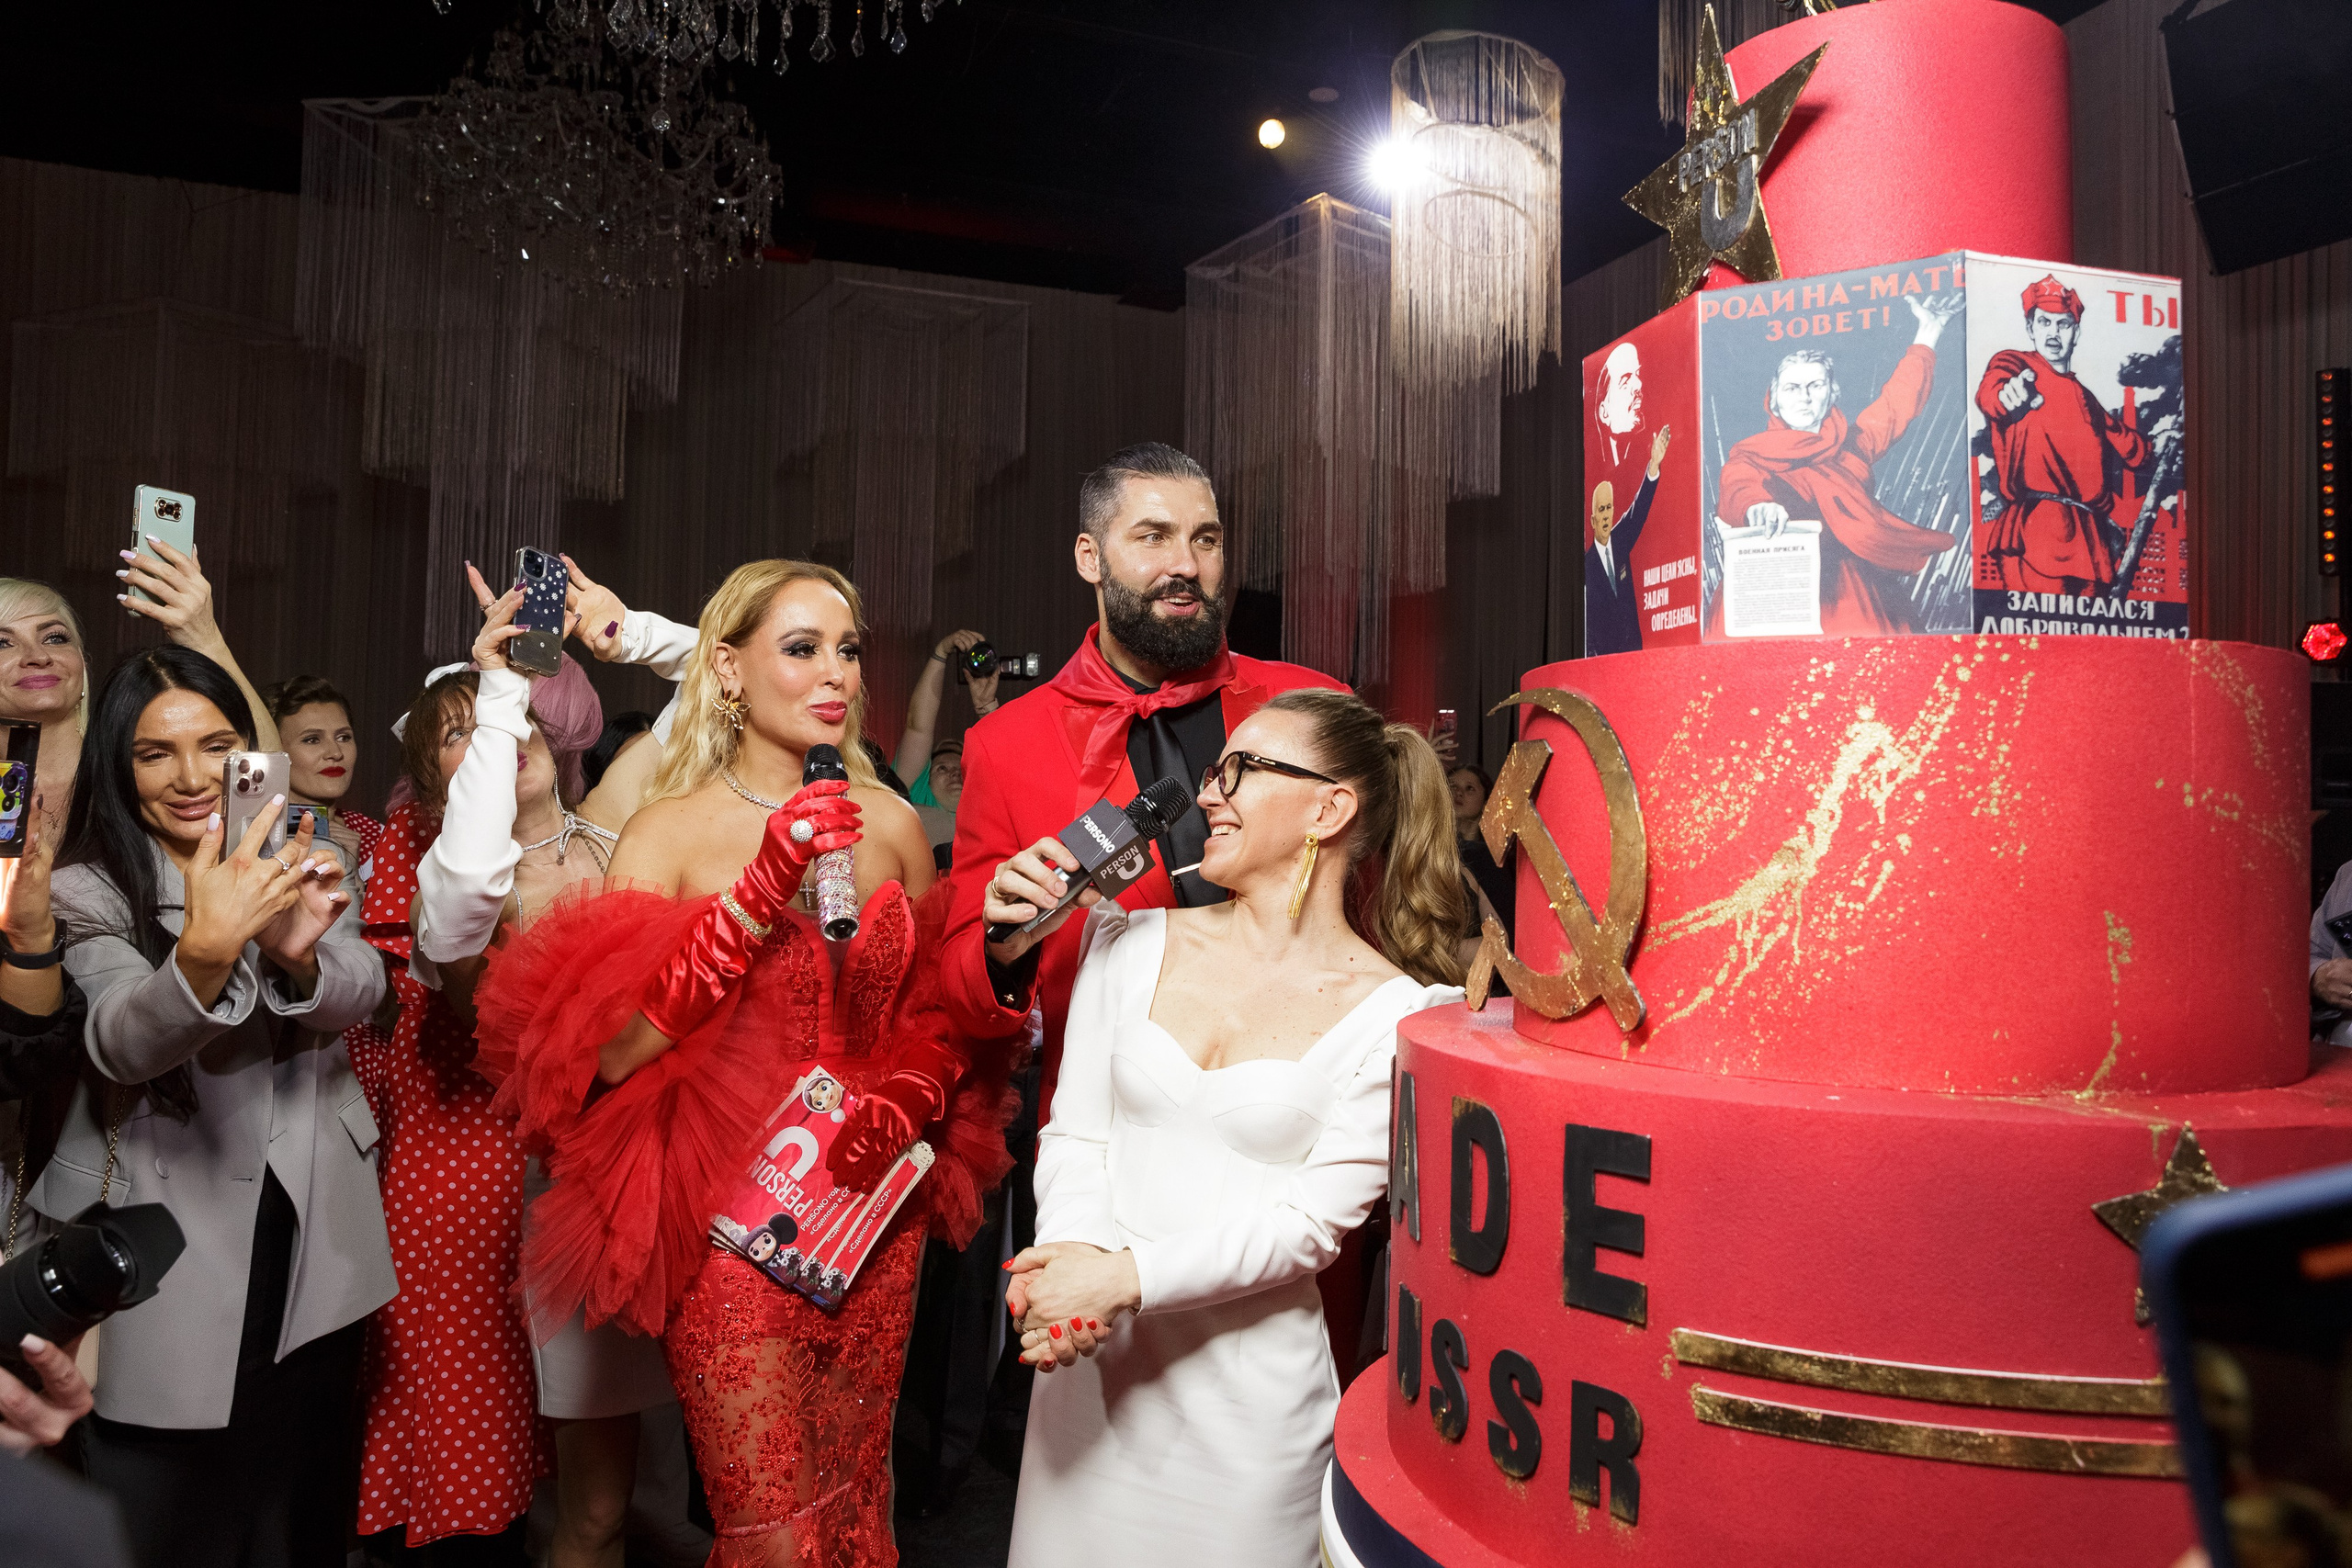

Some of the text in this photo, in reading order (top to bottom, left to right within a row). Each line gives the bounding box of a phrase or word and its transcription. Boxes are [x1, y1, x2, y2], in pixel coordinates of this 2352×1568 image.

[1765, 306, 1890, 342] ЗОВЕТ!
[2107, 289, 2178, 329] ТЫ
[1643, 587, 1668, 611] ЗАДАЧИ
[2007, 590, 2154, 621] ЗАПИСАЛСЯ
[1080, 815, 1116, 853] PERSONO
[1100, 845, 1140, 879] PERSON
[745, 1154, 814, 1218] PERSON
[1388, 1056, 1652, 1326] ADE
[799, 1198, 829, 1232] PERSONO
